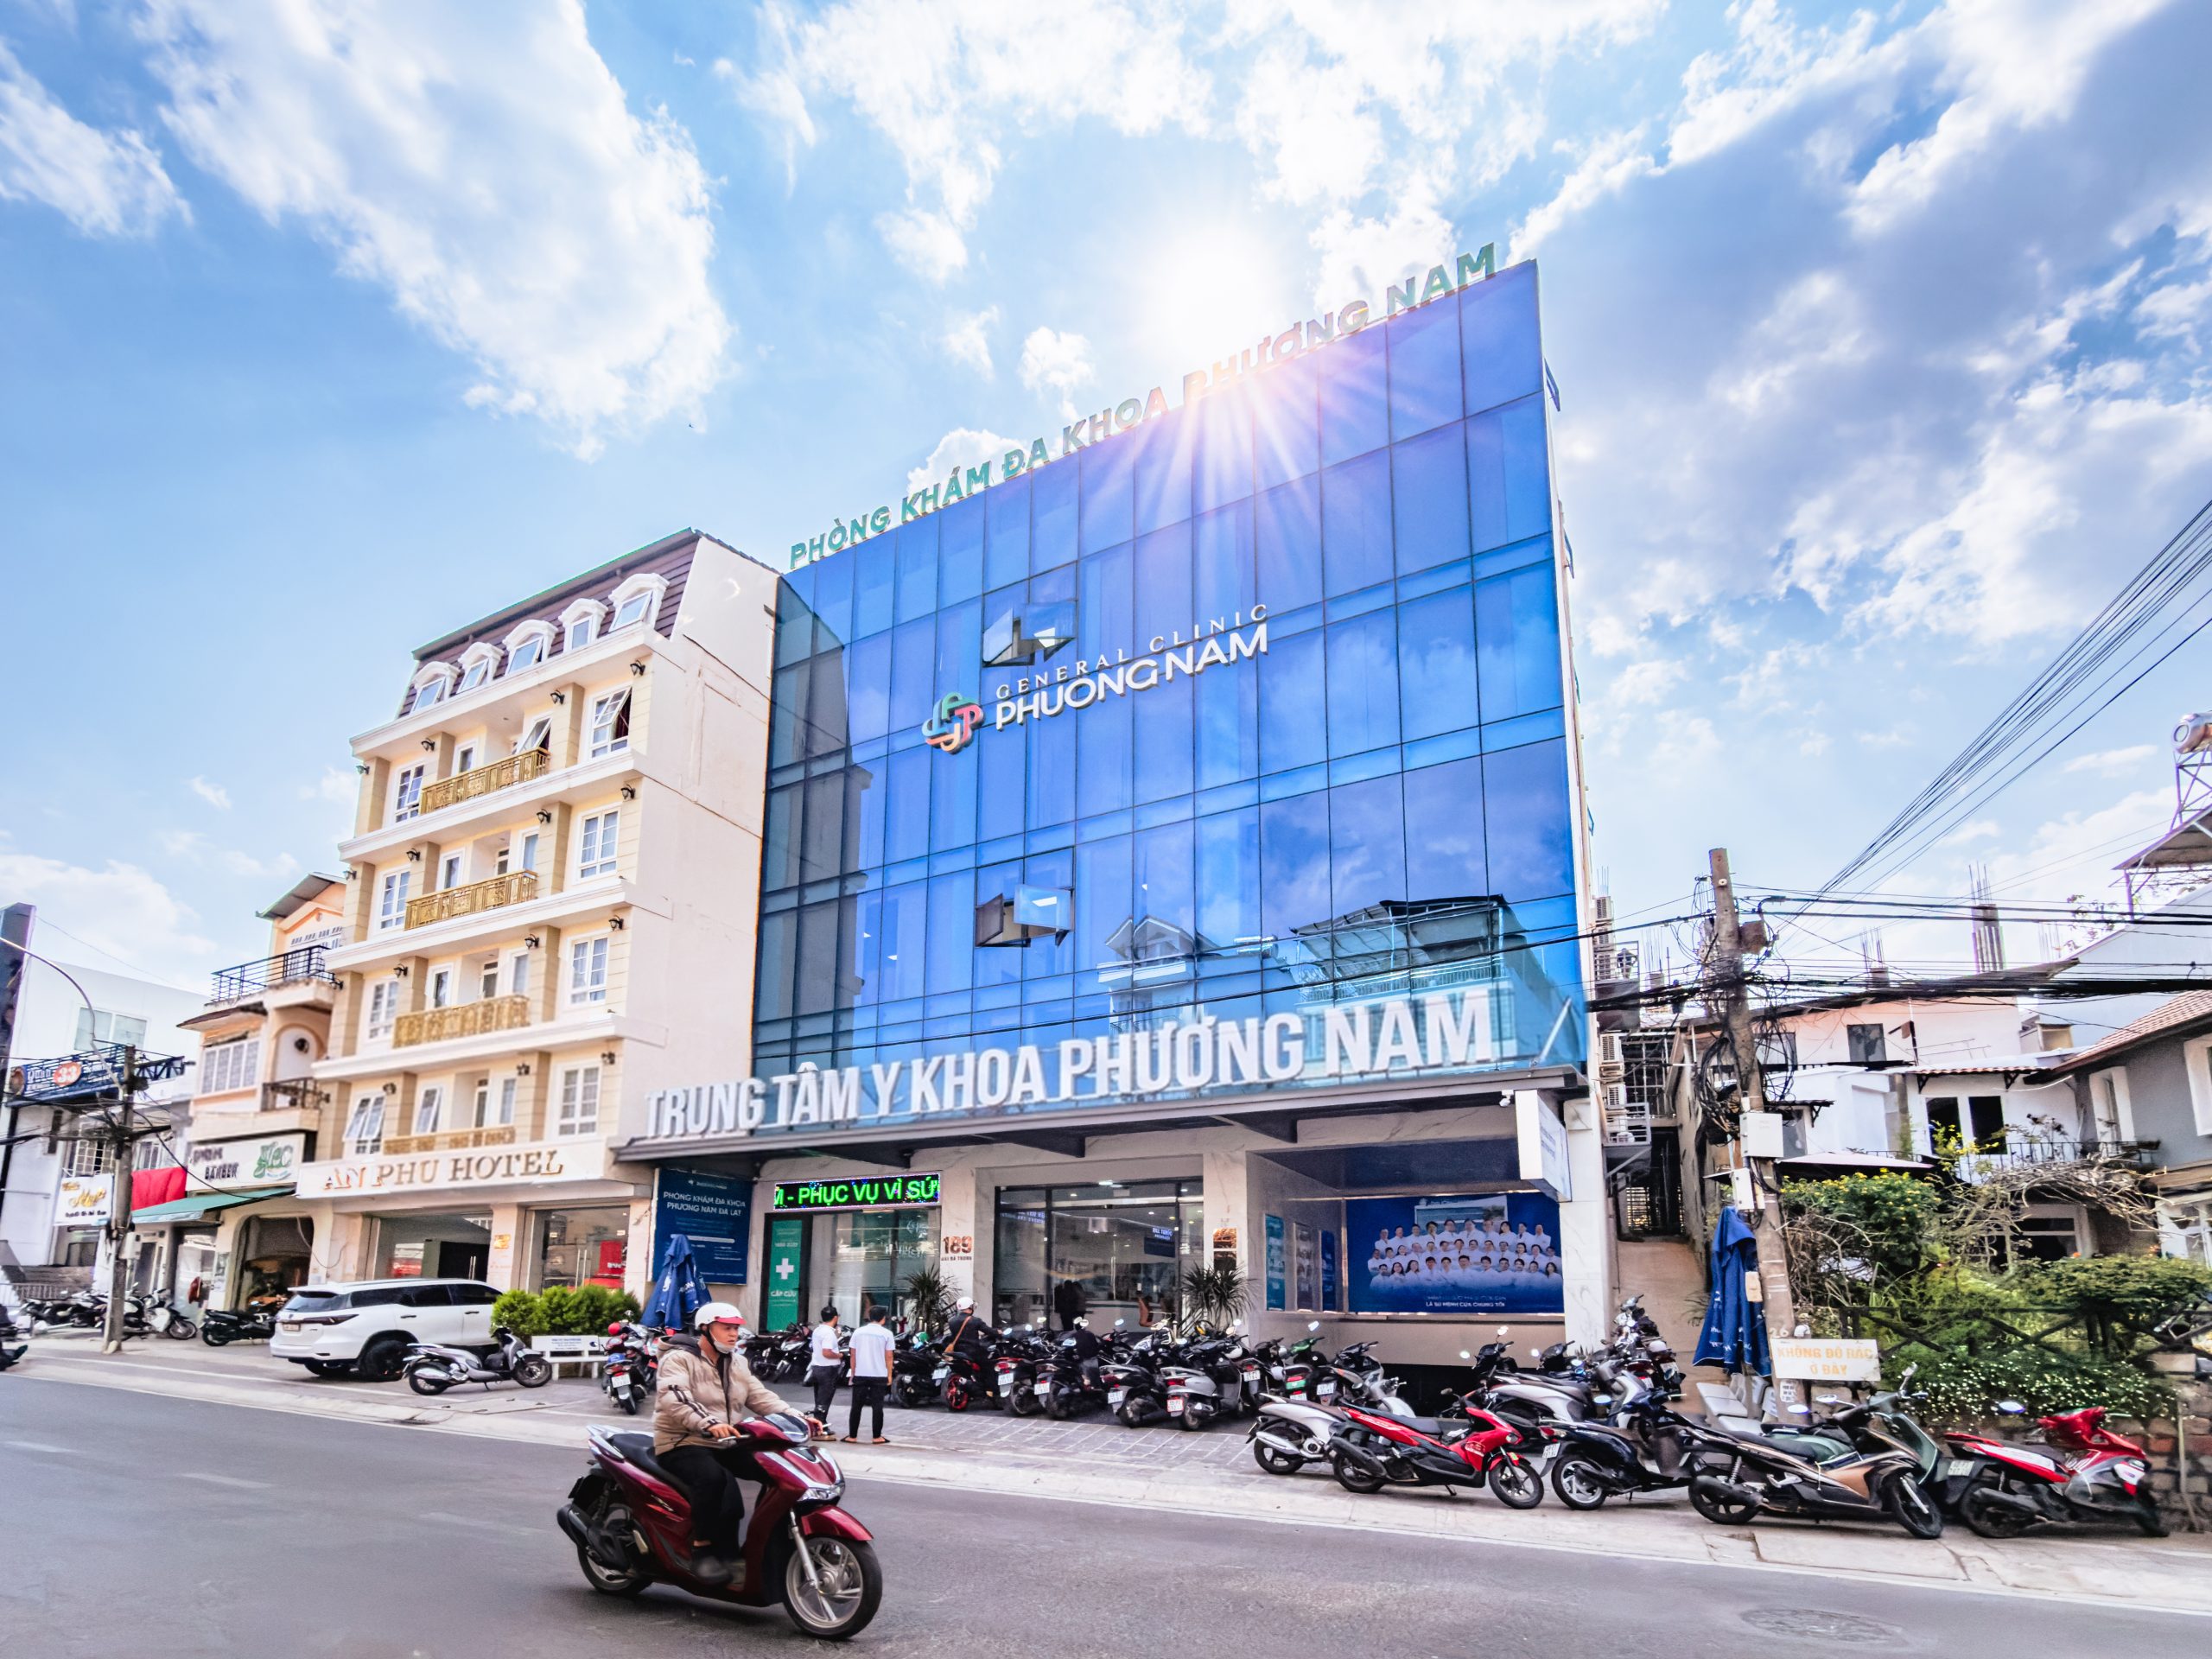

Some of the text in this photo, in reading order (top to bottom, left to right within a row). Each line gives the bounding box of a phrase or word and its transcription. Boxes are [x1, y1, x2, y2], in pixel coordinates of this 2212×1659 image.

[790, 242, 1496, 569] PHÒNG KHÁM ĐA KHOA PHƯƠNG NAM
[996, 604, 1267, 700] GENERAL CLINIC
[645, 987, 1497, 1140] TRUNG TÂM Y KHOA PHƯƠNG NAM
[324, 1166, 367, 1190] AN
[448, 1149, 563, 1182] HOTEL
[798, 1185, 849, 1206] PHỤC
[853, 1183, 880, 1205] VỤ
[884, 1178, 902, 1200] VÌ
[907, 1176, 940, 1199] SỨ
[943, 1236, 972, 1254] 189
